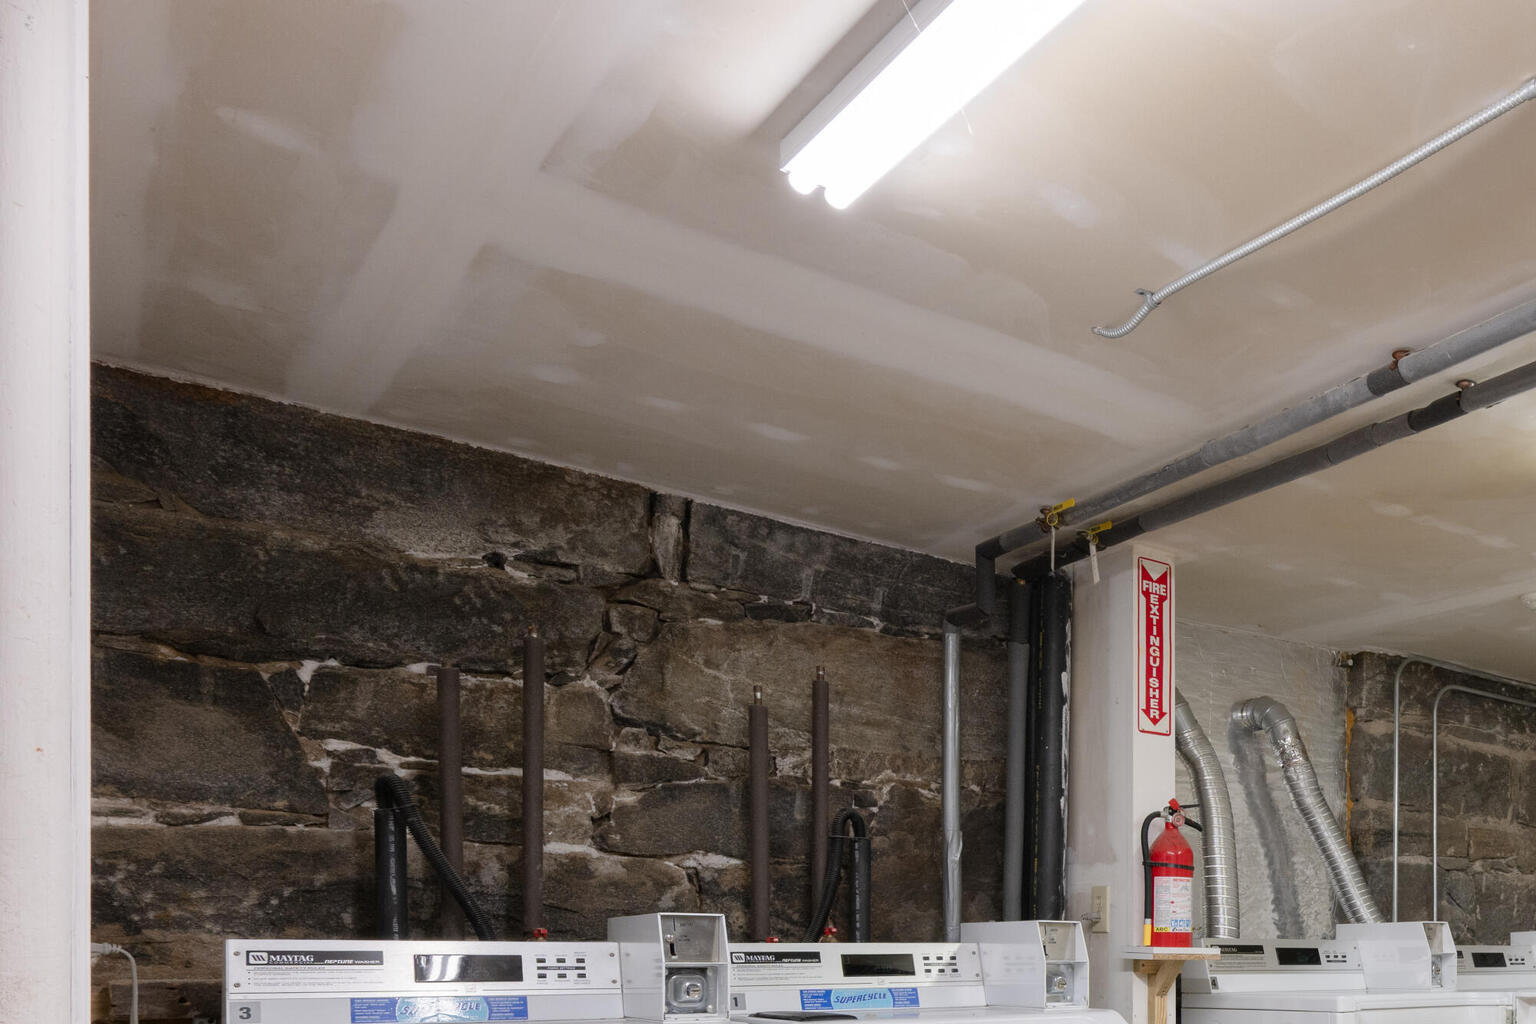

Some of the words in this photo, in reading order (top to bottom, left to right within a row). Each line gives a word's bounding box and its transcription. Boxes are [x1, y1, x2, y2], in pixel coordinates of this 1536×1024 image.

[1143, 580, 1167, 596] FIRE
[1149, 594, 1160, 720] EXTINGUISHER
[269, 954, 314, 962] MAYTAG
[733, 996, 738, 1007] 1
[239, 1007, 251, 1020] 3
